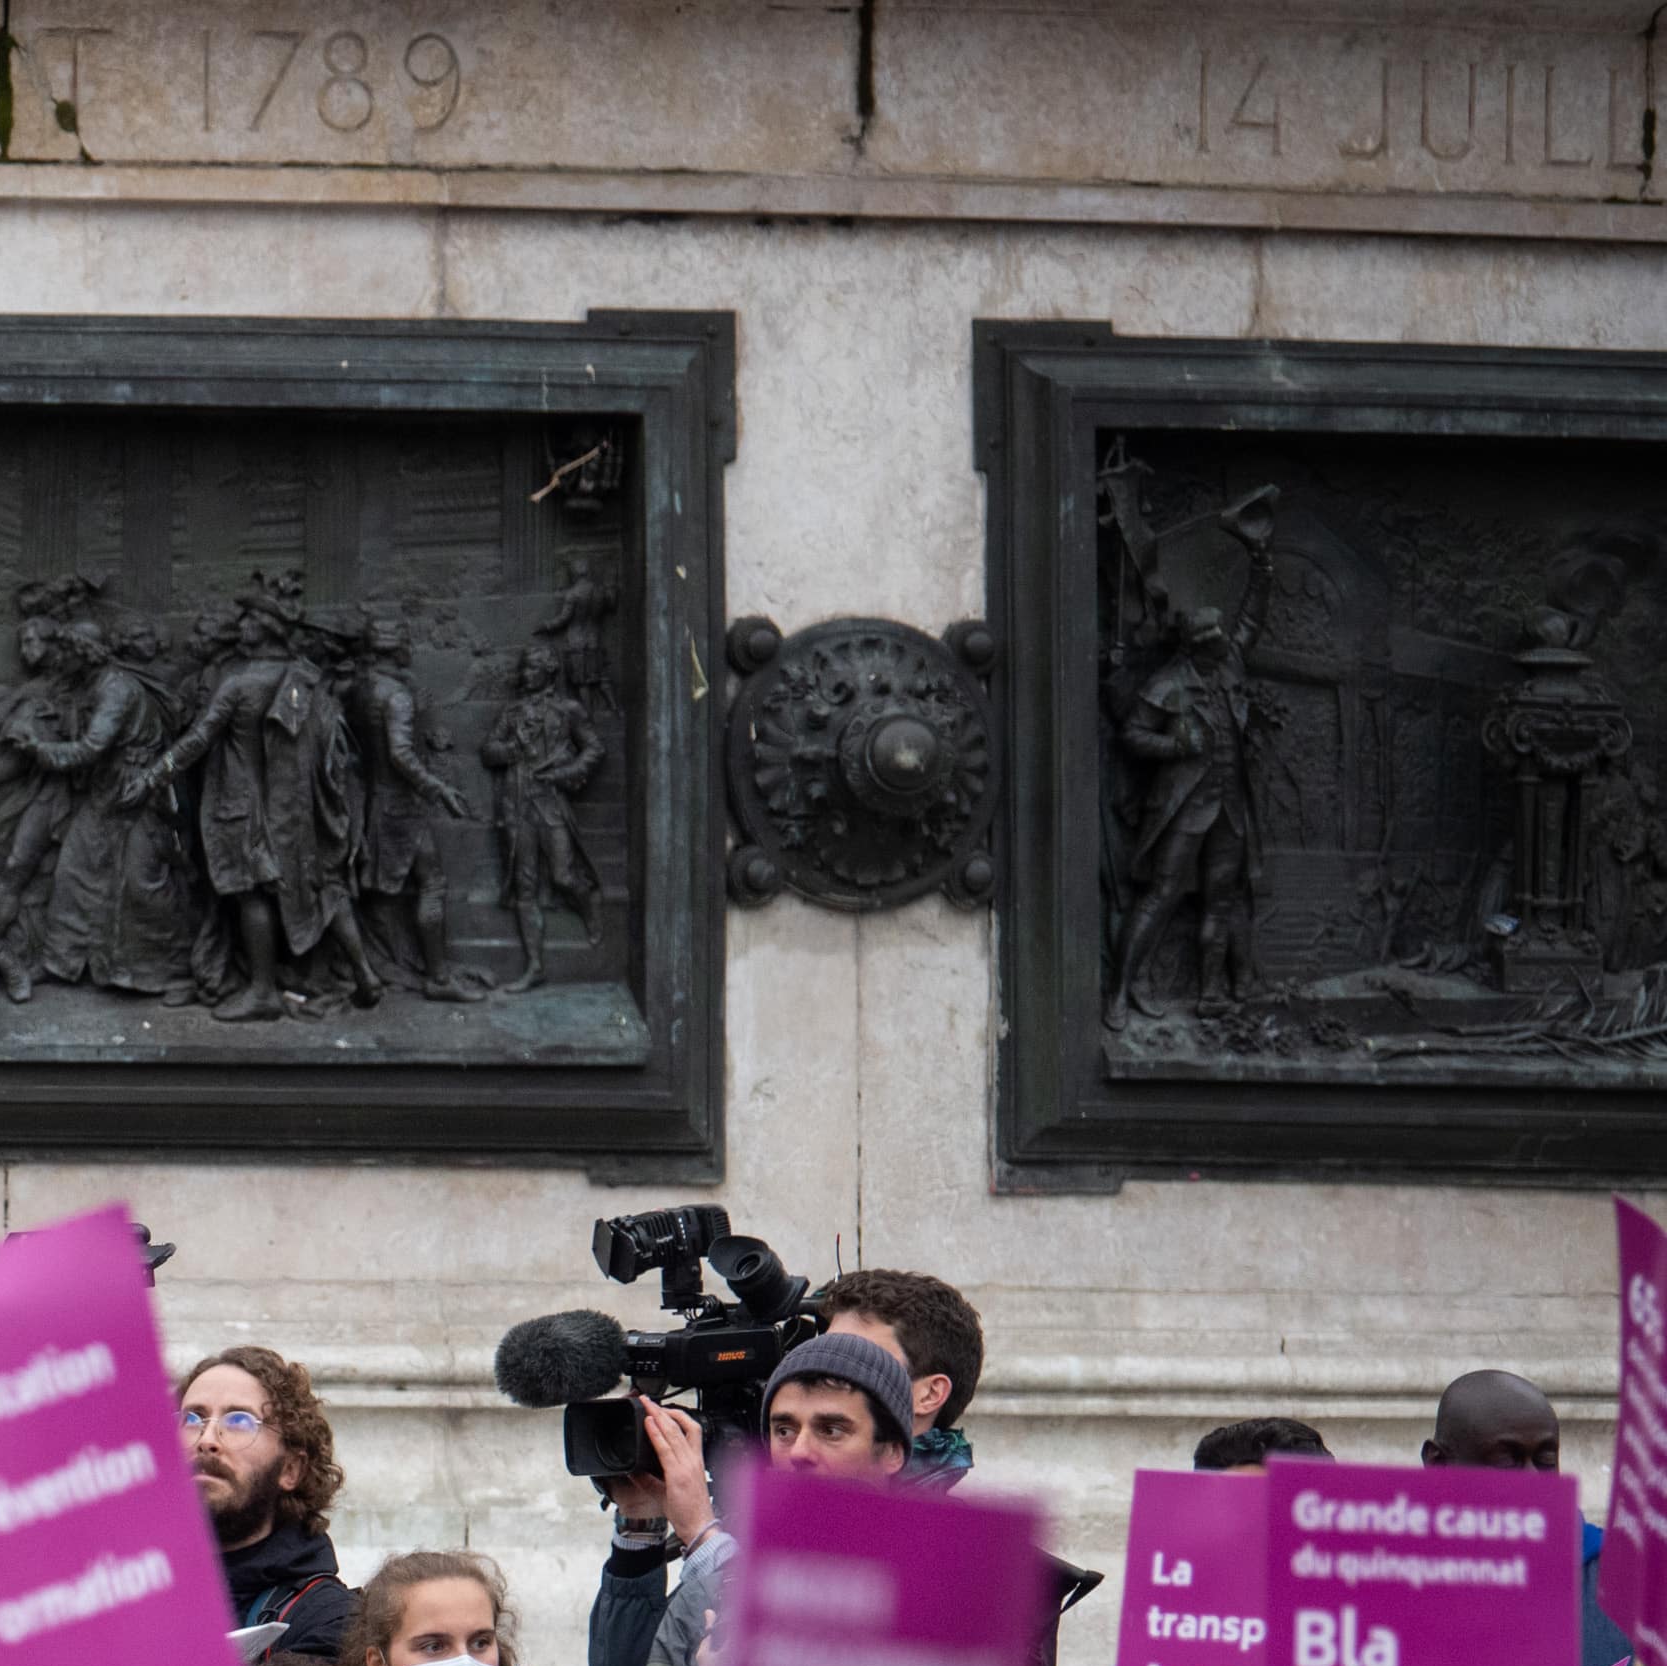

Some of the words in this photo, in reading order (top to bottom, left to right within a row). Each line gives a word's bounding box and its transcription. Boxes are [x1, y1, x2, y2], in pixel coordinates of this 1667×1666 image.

[199, 28, 462, 134] 1789
[1196, 48, 1285, 157] 14
[1292, 1490, 1430, 1537] Grande
[1436, 1507, 1547, 1540] cause
[1152, 1551, 1193, 1587] La
[1291, 1543, 1333, 1577] du
[1338, 1548, 1527, 1588] quinquennat
[1147, 1606, 1266, 1652] transp
